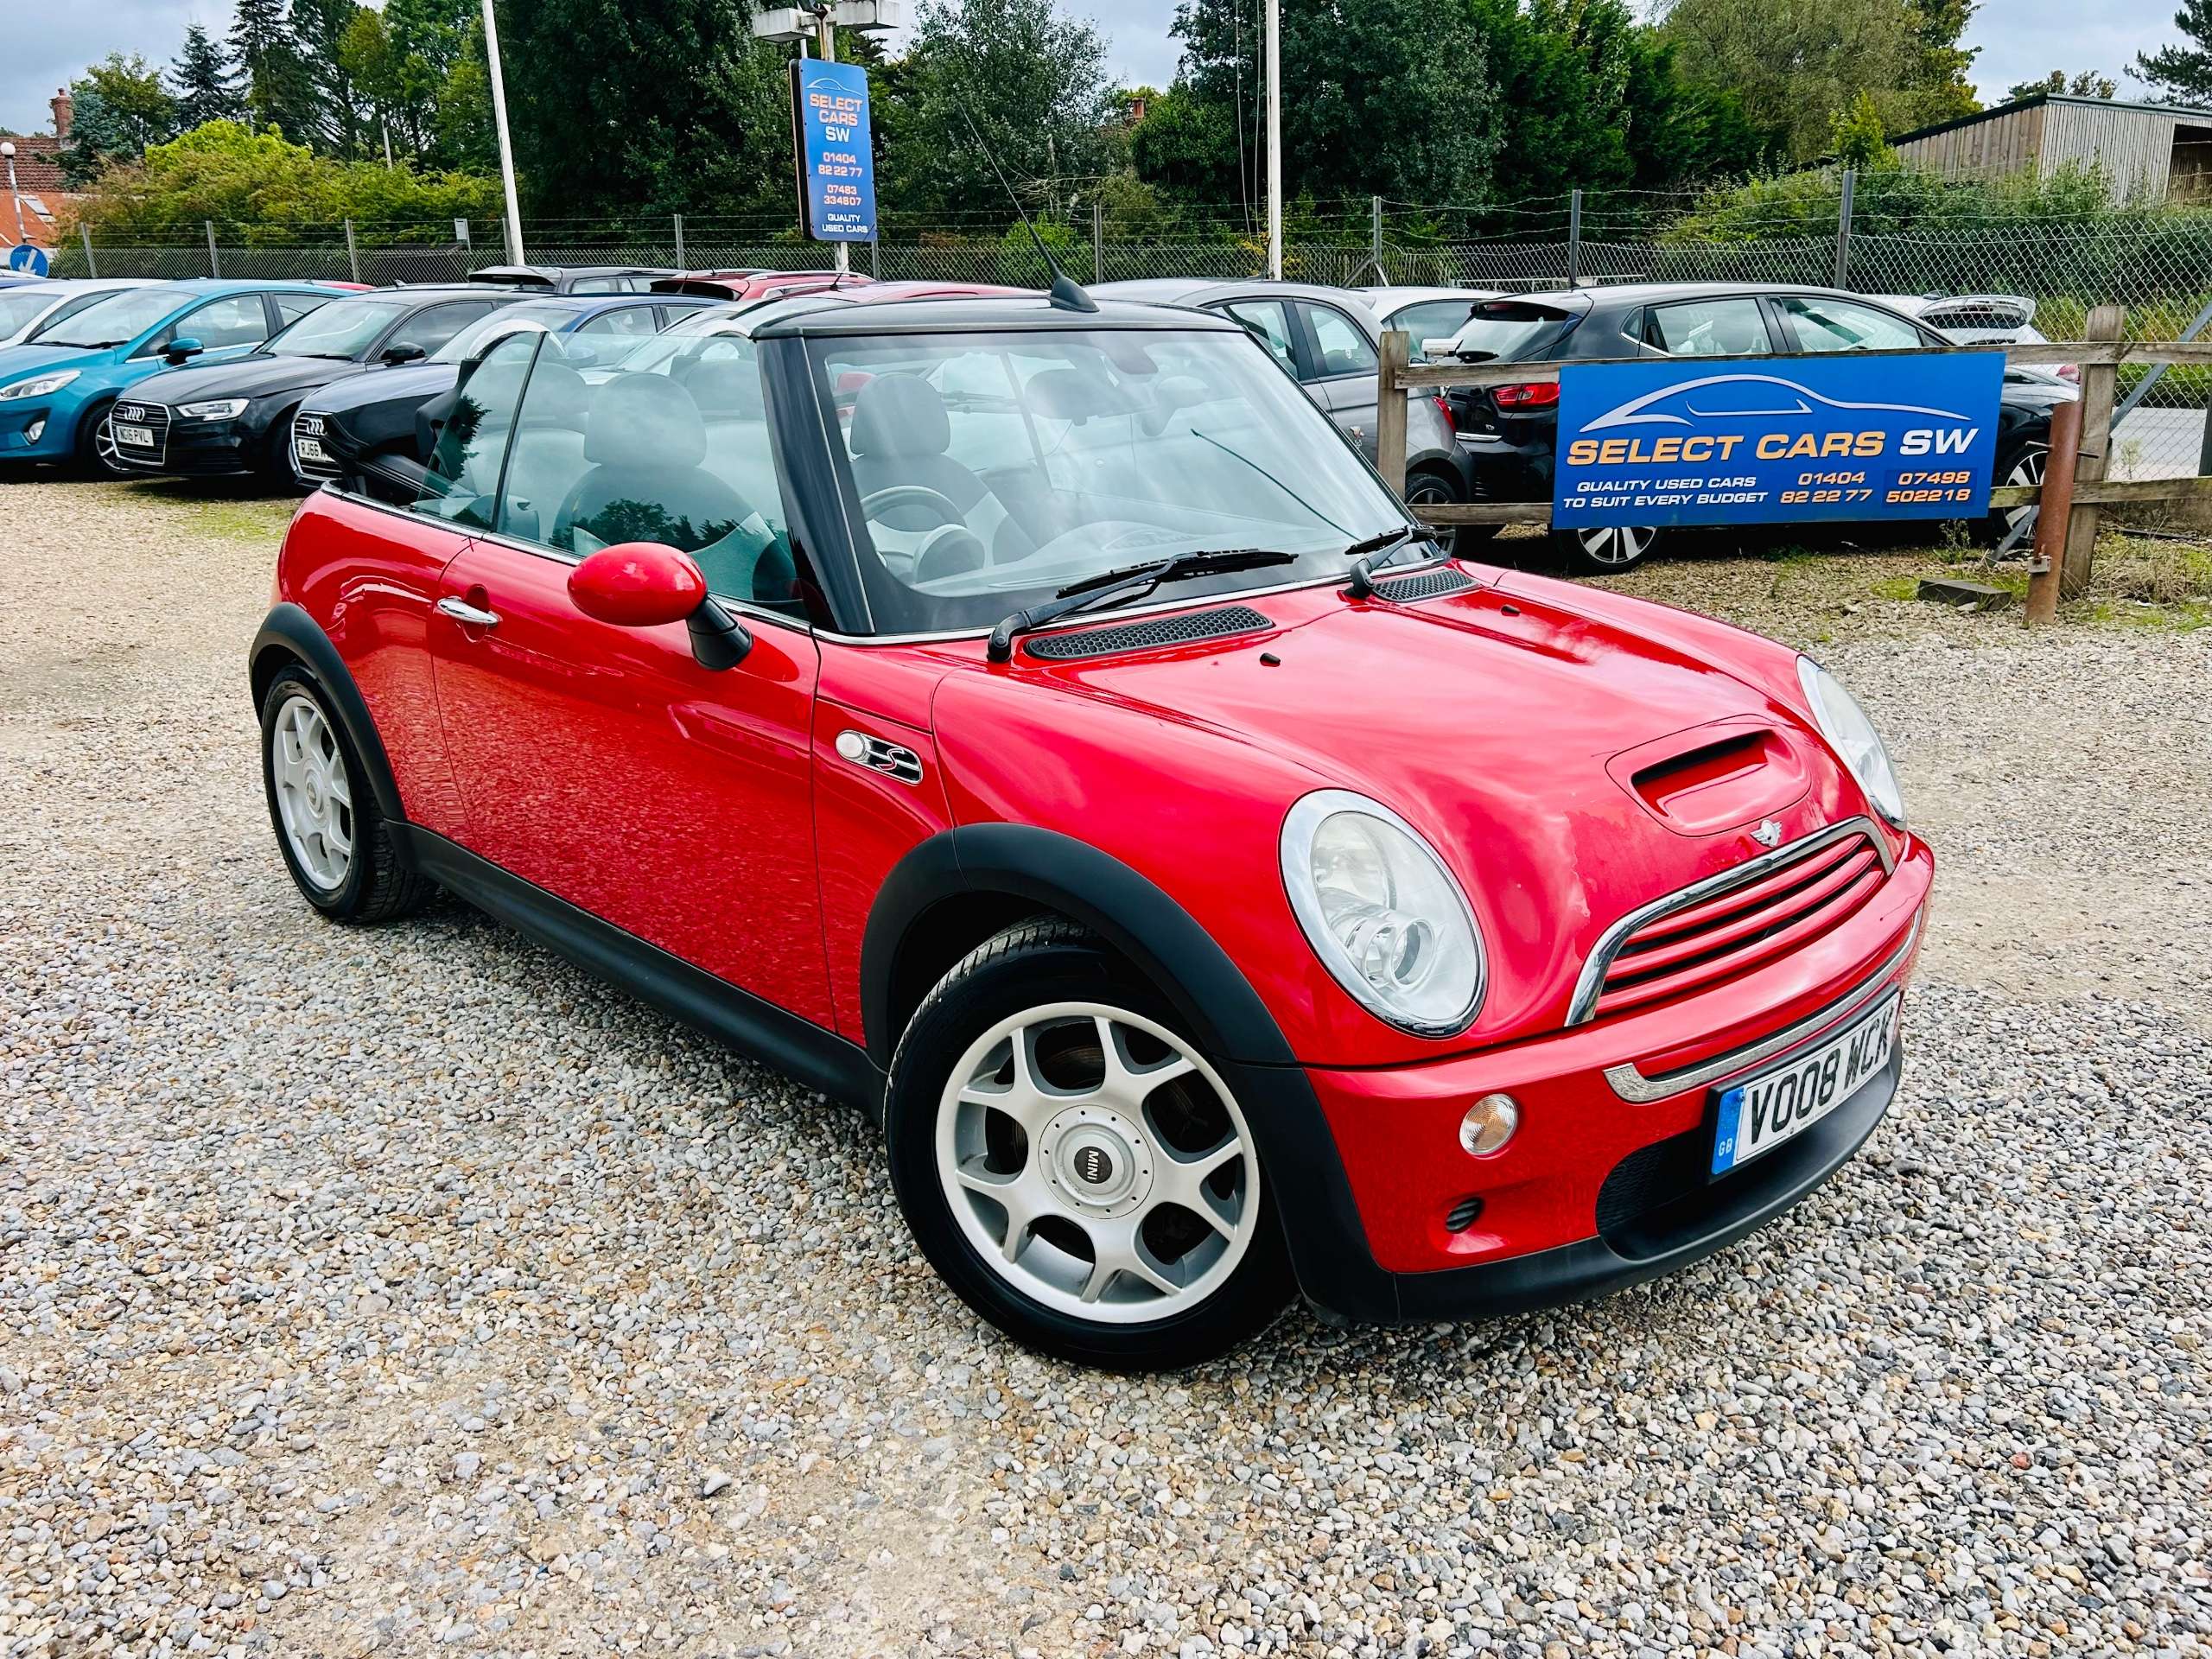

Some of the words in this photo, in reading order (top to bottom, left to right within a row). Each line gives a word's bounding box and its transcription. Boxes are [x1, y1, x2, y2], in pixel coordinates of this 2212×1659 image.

[810, 92, 862, 111] SELECT
[819, 110, 858, 127] CARS
[825, 126, 850, 142] SW
[823, 152, 856, 164] 01404
[818, 164, 832, 175] 82
[834, 166, 848, 176] 22
[849, 167, 862, 177] 77
[827, 213, 861, 222] QUALITY
[822, 224, 844, 232] USED
[846, 225, 868, 233] CARS
[301, 442, 320, 457] RJ66
[1567, 435, 1745, 466] SELECT
[1755, 430, 1885, 461] CARS
[1899, 428, 1980, 455] SW
[1576, 480, 1652, 493] QUALITY
[1655, 478, 1704, 490] USED
[1707, 476, 1757, 488] CARS
[1797, 471, 1866, 486] 01404
[1897, 471, 1971, 486] 07498
[1563, 497, 1586, 508] TO
[1590, 495, 1631, 508] SUIT
[1634, 494, 1694, 506] EVERY
[1696, 492, 1769, 505] BUDGET
[1780, 490, 1809, 504] 82
[1811, 489, 1841, 503] 22
[1845, 488, 1873, 502] 77
[1885, 488, 1971, 503] 502218
[1843, 1004, 1895, 1090] WCK
[1718, 1137, 1733, 1158] GB
[1087, 1149, 1100, 1181] MINI
